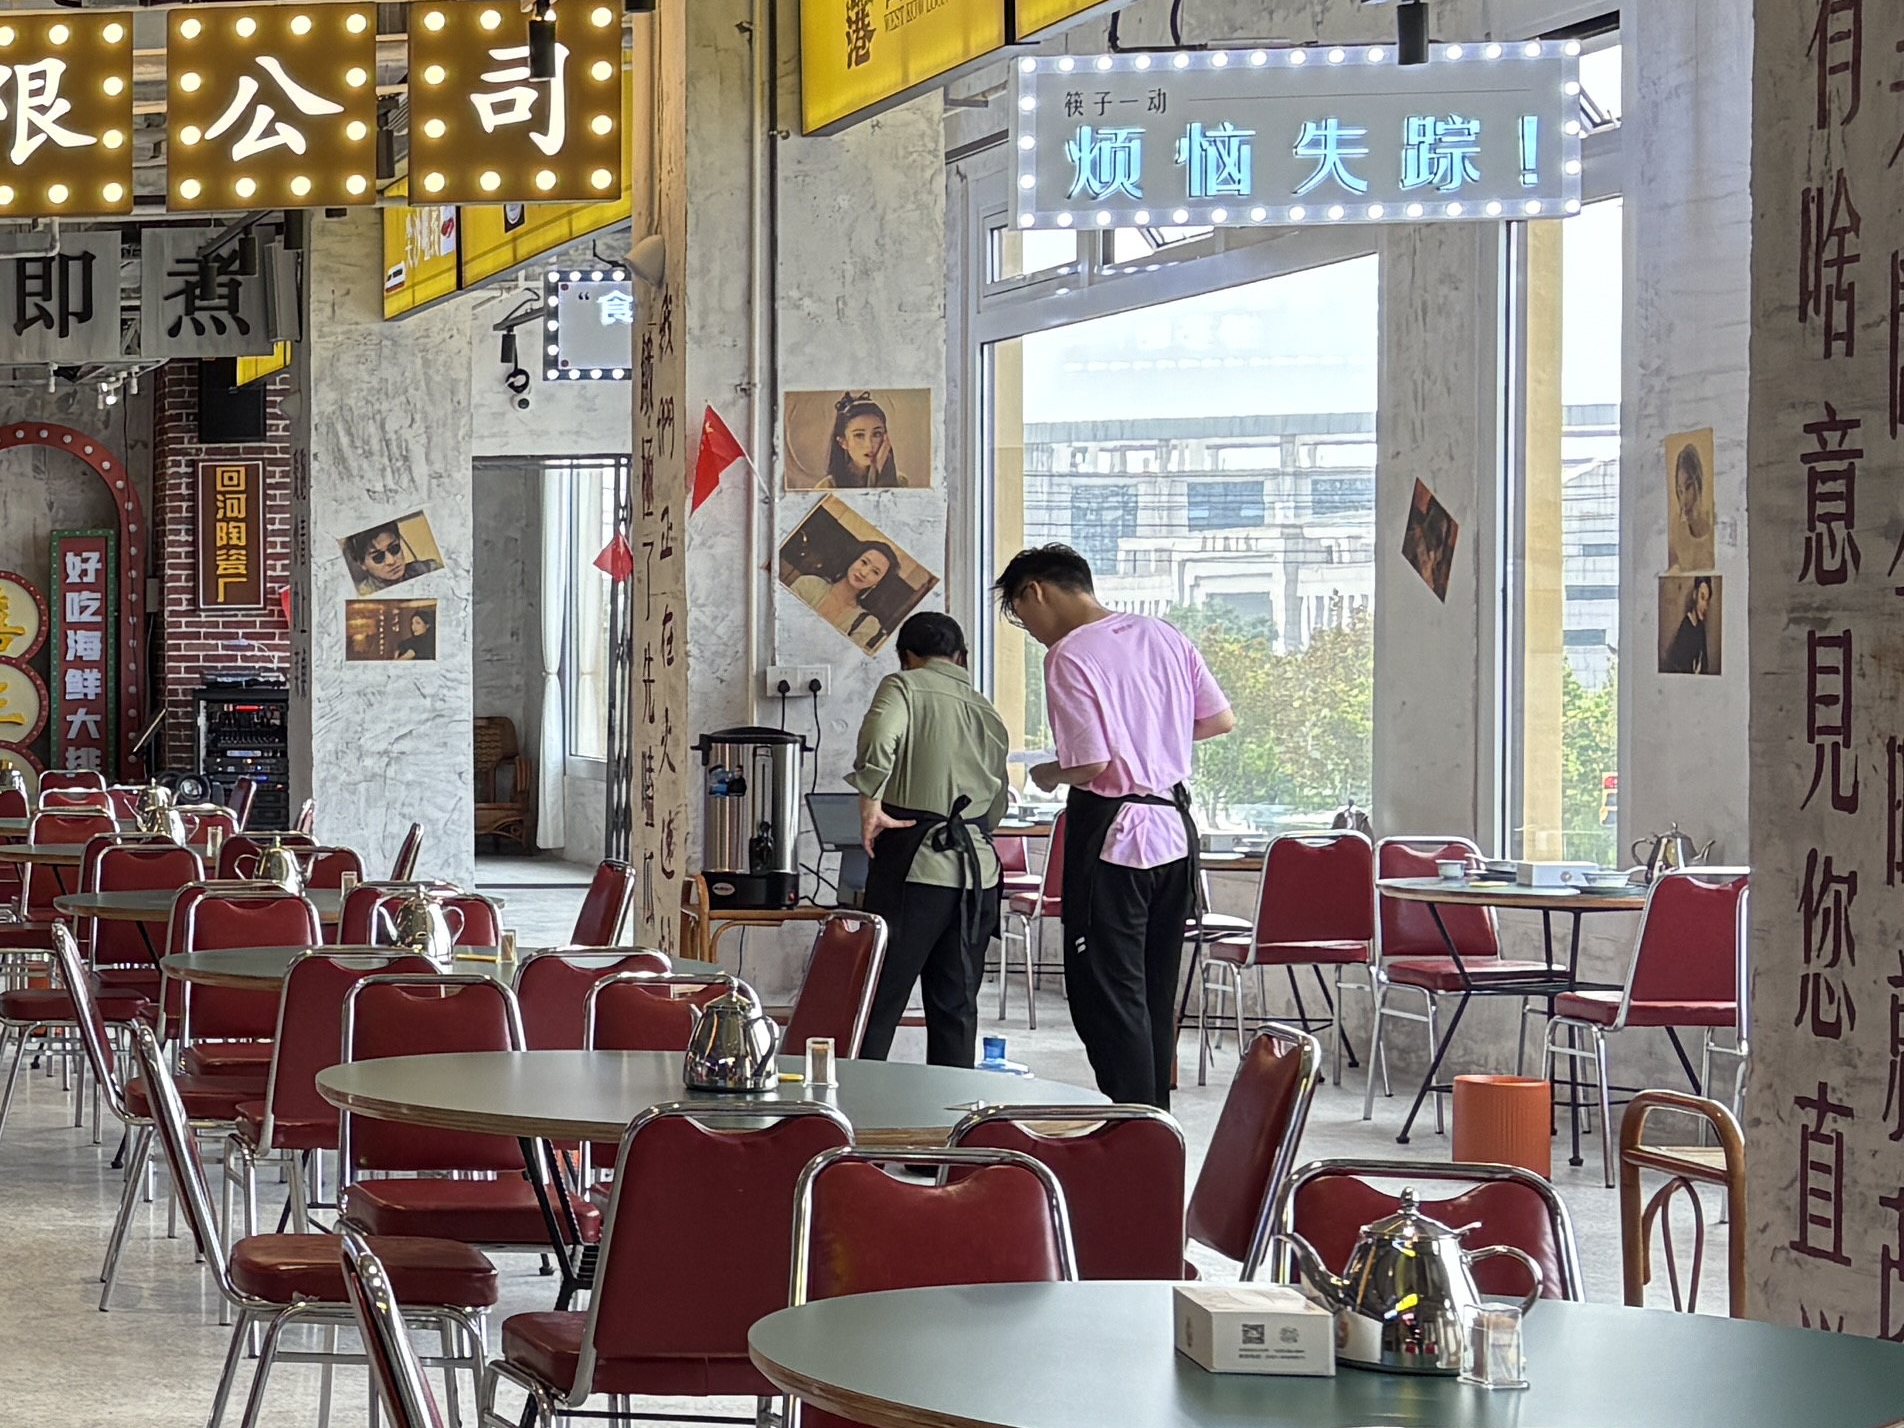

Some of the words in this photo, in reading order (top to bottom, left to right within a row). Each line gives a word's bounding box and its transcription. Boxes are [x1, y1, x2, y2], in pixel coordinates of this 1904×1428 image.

[1065, 88, 1167, 117] 筷子一动
[1066, 113, 1541, 200] 烦恼失踪！
[215, 466, 247, 603] 回河陶瓷厂
